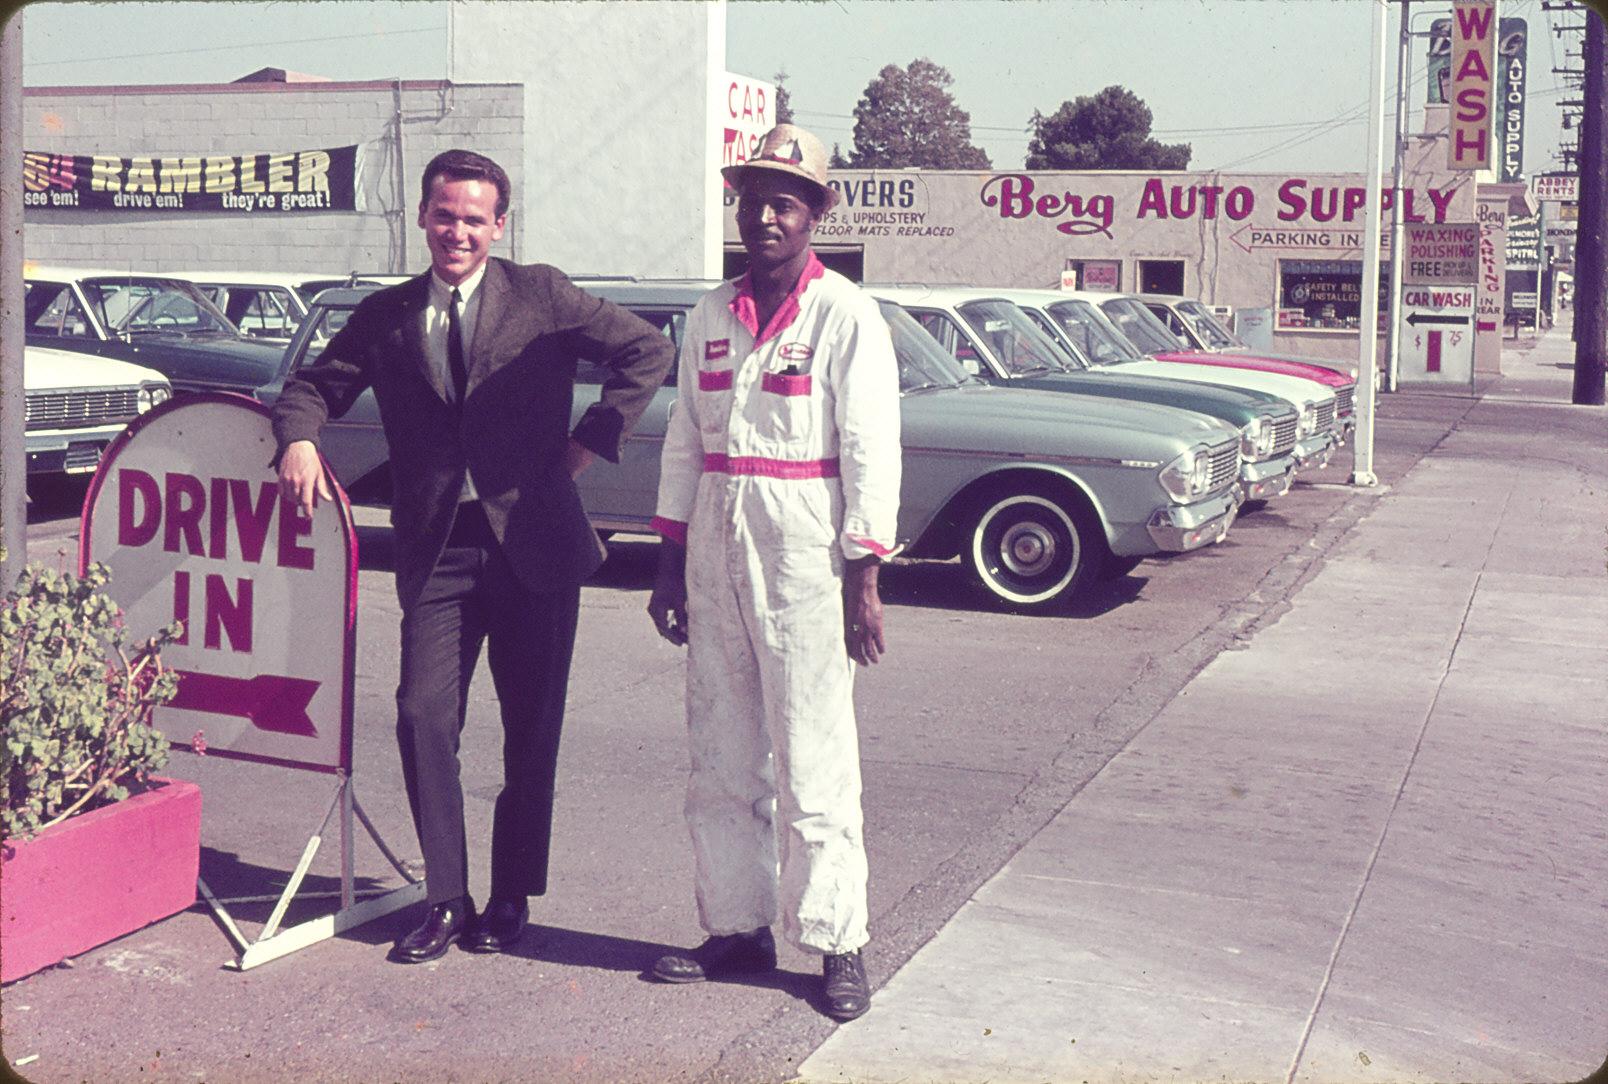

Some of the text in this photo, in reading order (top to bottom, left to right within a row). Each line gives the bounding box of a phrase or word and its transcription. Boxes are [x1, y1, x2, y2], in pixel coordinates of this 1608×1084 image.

[1455, 8, 1493, 161] WASH
[728, 81, 766, 125] CAR
[1505, 58, 1522, 178] AUTO SUPPLY
[91, 150, 331, 193] RAMBLER
[1538, 177, 1577, 186] ABBEY
[1537, 187, 1575, 195] RENTS
[113, 192, 151, 207] drive
[222, 191, 275, 211] they're
[281, 188, 331, 210] great!
[981, 174, 1114, 240] Berg
[1136, 178, 1255, 221] AUTO
[853, 212, 926, 225] UPHOLSTERY
[1476, 204, 1505, 231] Berg
[814, 225, 955, 237] FLOOR MATS REPLACED
[1251, 232, 1360, 246] PARKING IN
[1411, 229, 1475, 243] WAXING
[1410, 244, 1476, 258] POLISHING
[1410, 261, 1442, 277] FREE
[1480, 230, 1500, 292] PARKING
[1304, 282, 1363, 293] SAFETY BEL
[1311, 292, 1360, 301] INSTALLED
[1405, 292, 1472, 308] CAR WASH
[1480, 298, 1494, 306] IN
[118, 468, 314, 570] DRIVE
[170, 570, 254, 655] IN
